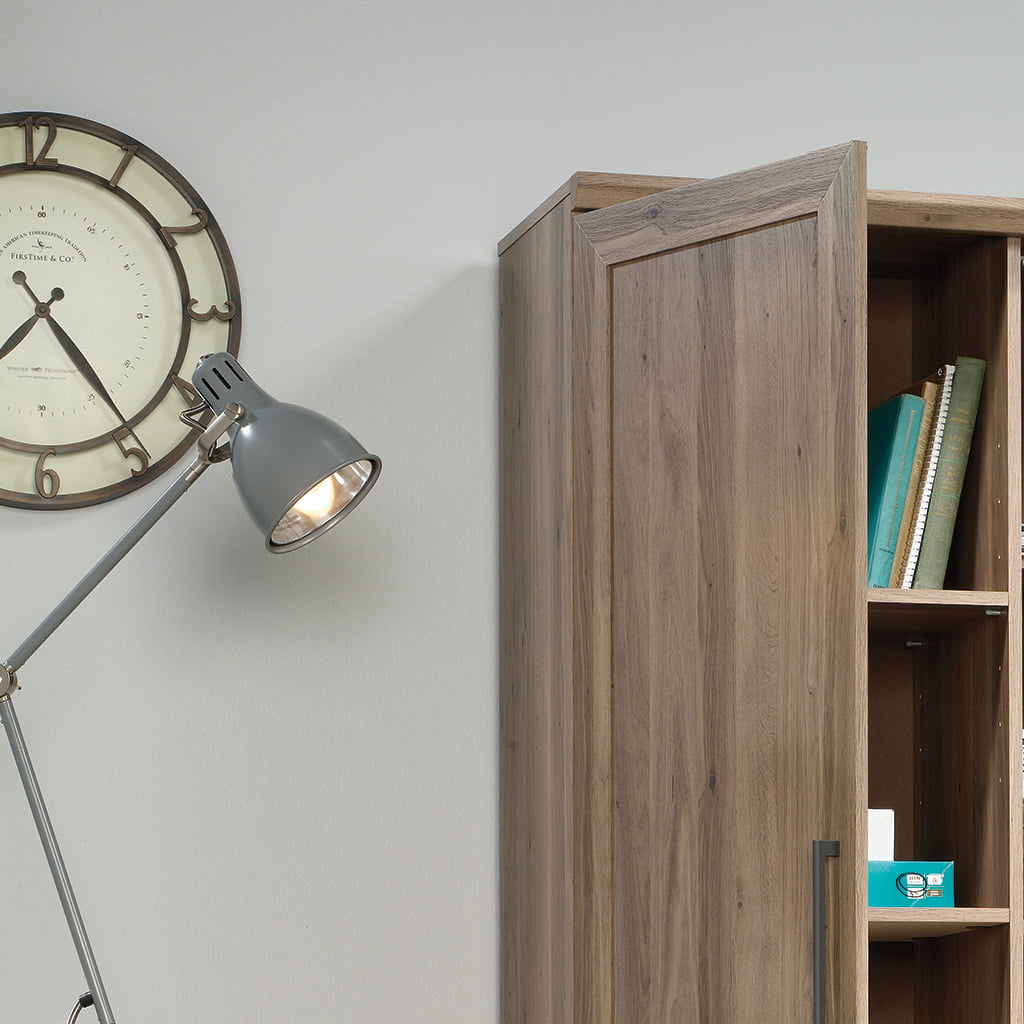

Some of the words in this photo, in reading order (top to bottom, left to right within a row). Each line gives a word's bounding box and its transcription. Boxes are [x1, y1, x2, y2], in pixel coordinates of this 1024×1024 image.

[17, 116, 58, 167] 12
[109, 145, 138, 188] 1
[159, 208, 209, 249] 2
[186, 298, 237, 322] 3
[36, 404, 47, 412] 30
[111, 427, 149, 477] 5
[34, 449, 60, 499] 6
